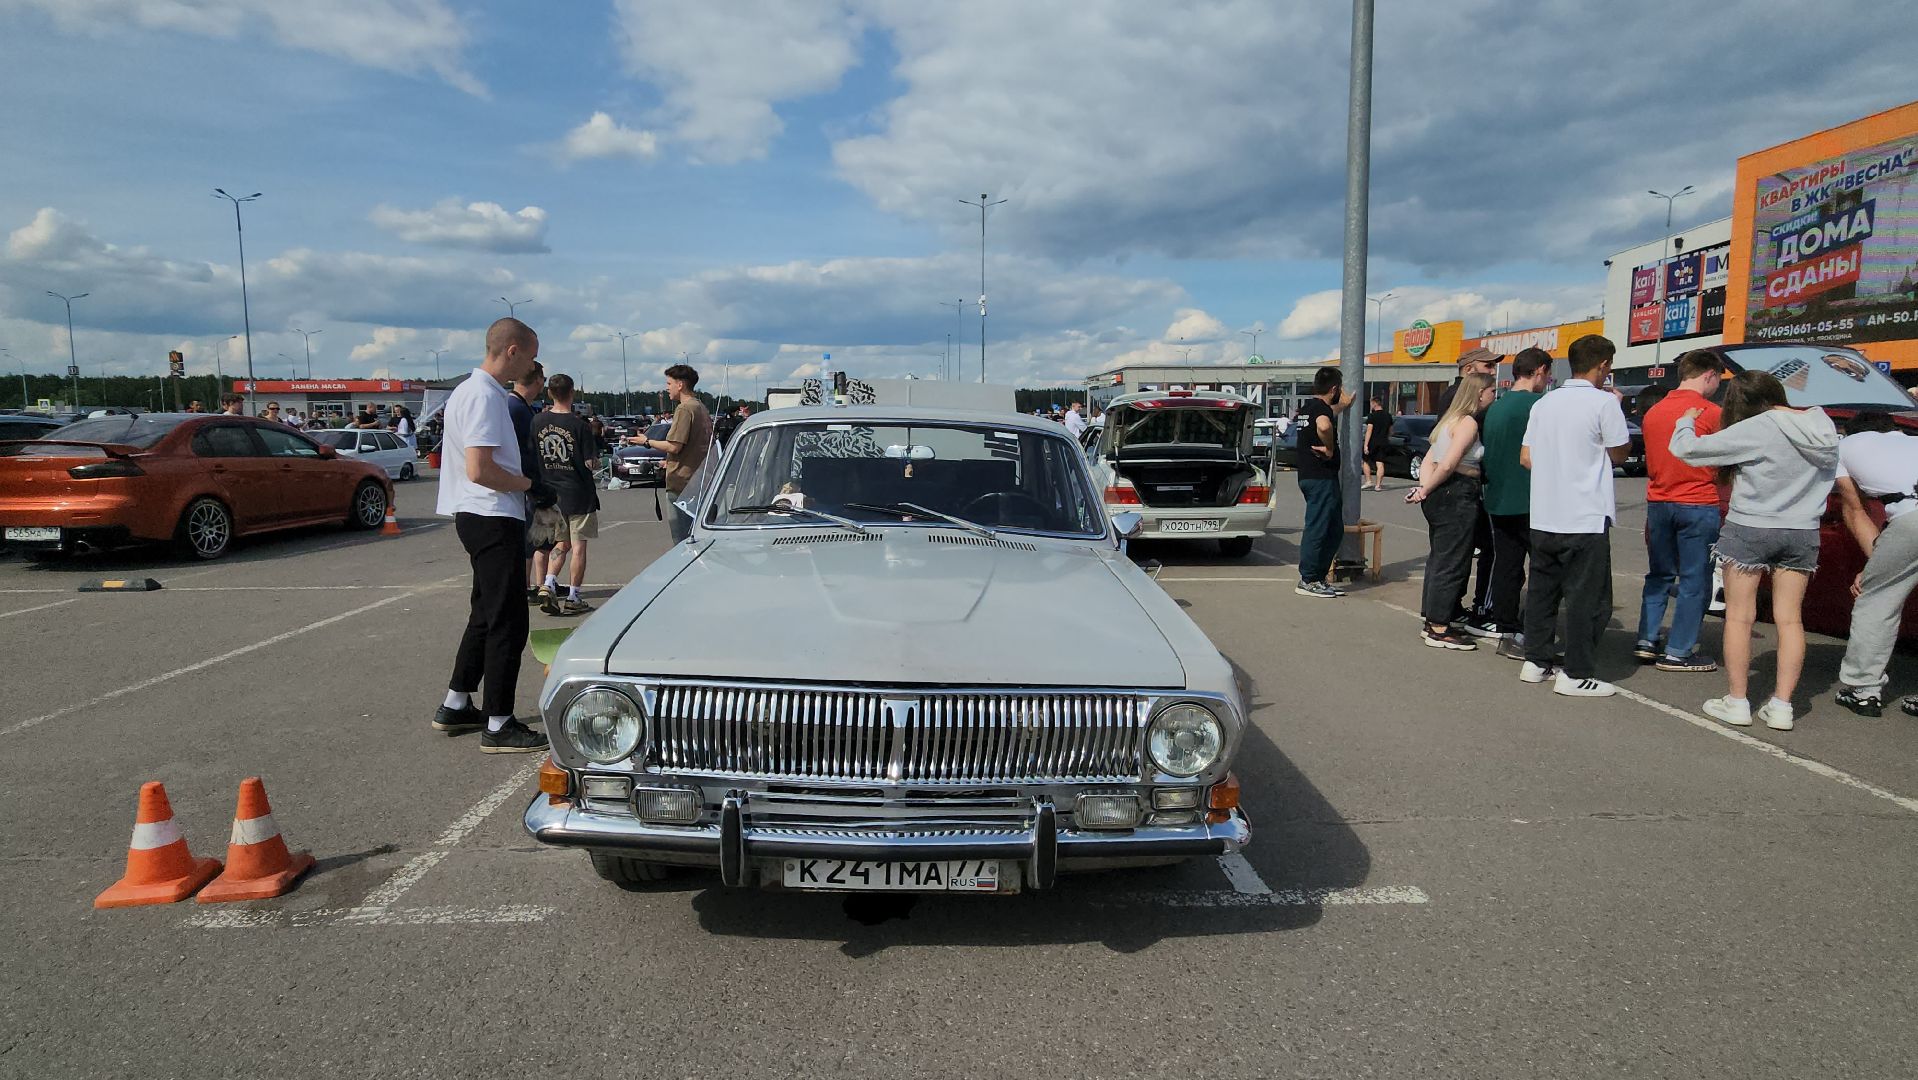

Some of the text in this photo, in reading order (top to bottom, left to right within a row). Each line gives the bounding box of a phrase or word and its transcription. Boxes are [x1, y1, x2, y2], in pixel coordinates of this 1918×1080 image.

[1759, 160, 1845, 210] КВАРТИРЫ
[1791, 198, 1801, 213] В
[1804, 184, 1831, 208] ЖК
[1772, 211, 1818, 237] СКИДКИ!
[1777, 208, 1872, 269] ДОМА
[1635, 271, 1655, 290] kari
[1769, 250, 1857, 298] СДАНЫ
[1665, 303, 1688, 321] kari
[1757, 318, 1854, 339] +7(495)661-05-55
[800, 860, 942, 886] К241МА
[950, 878, 976, 888] RUS
